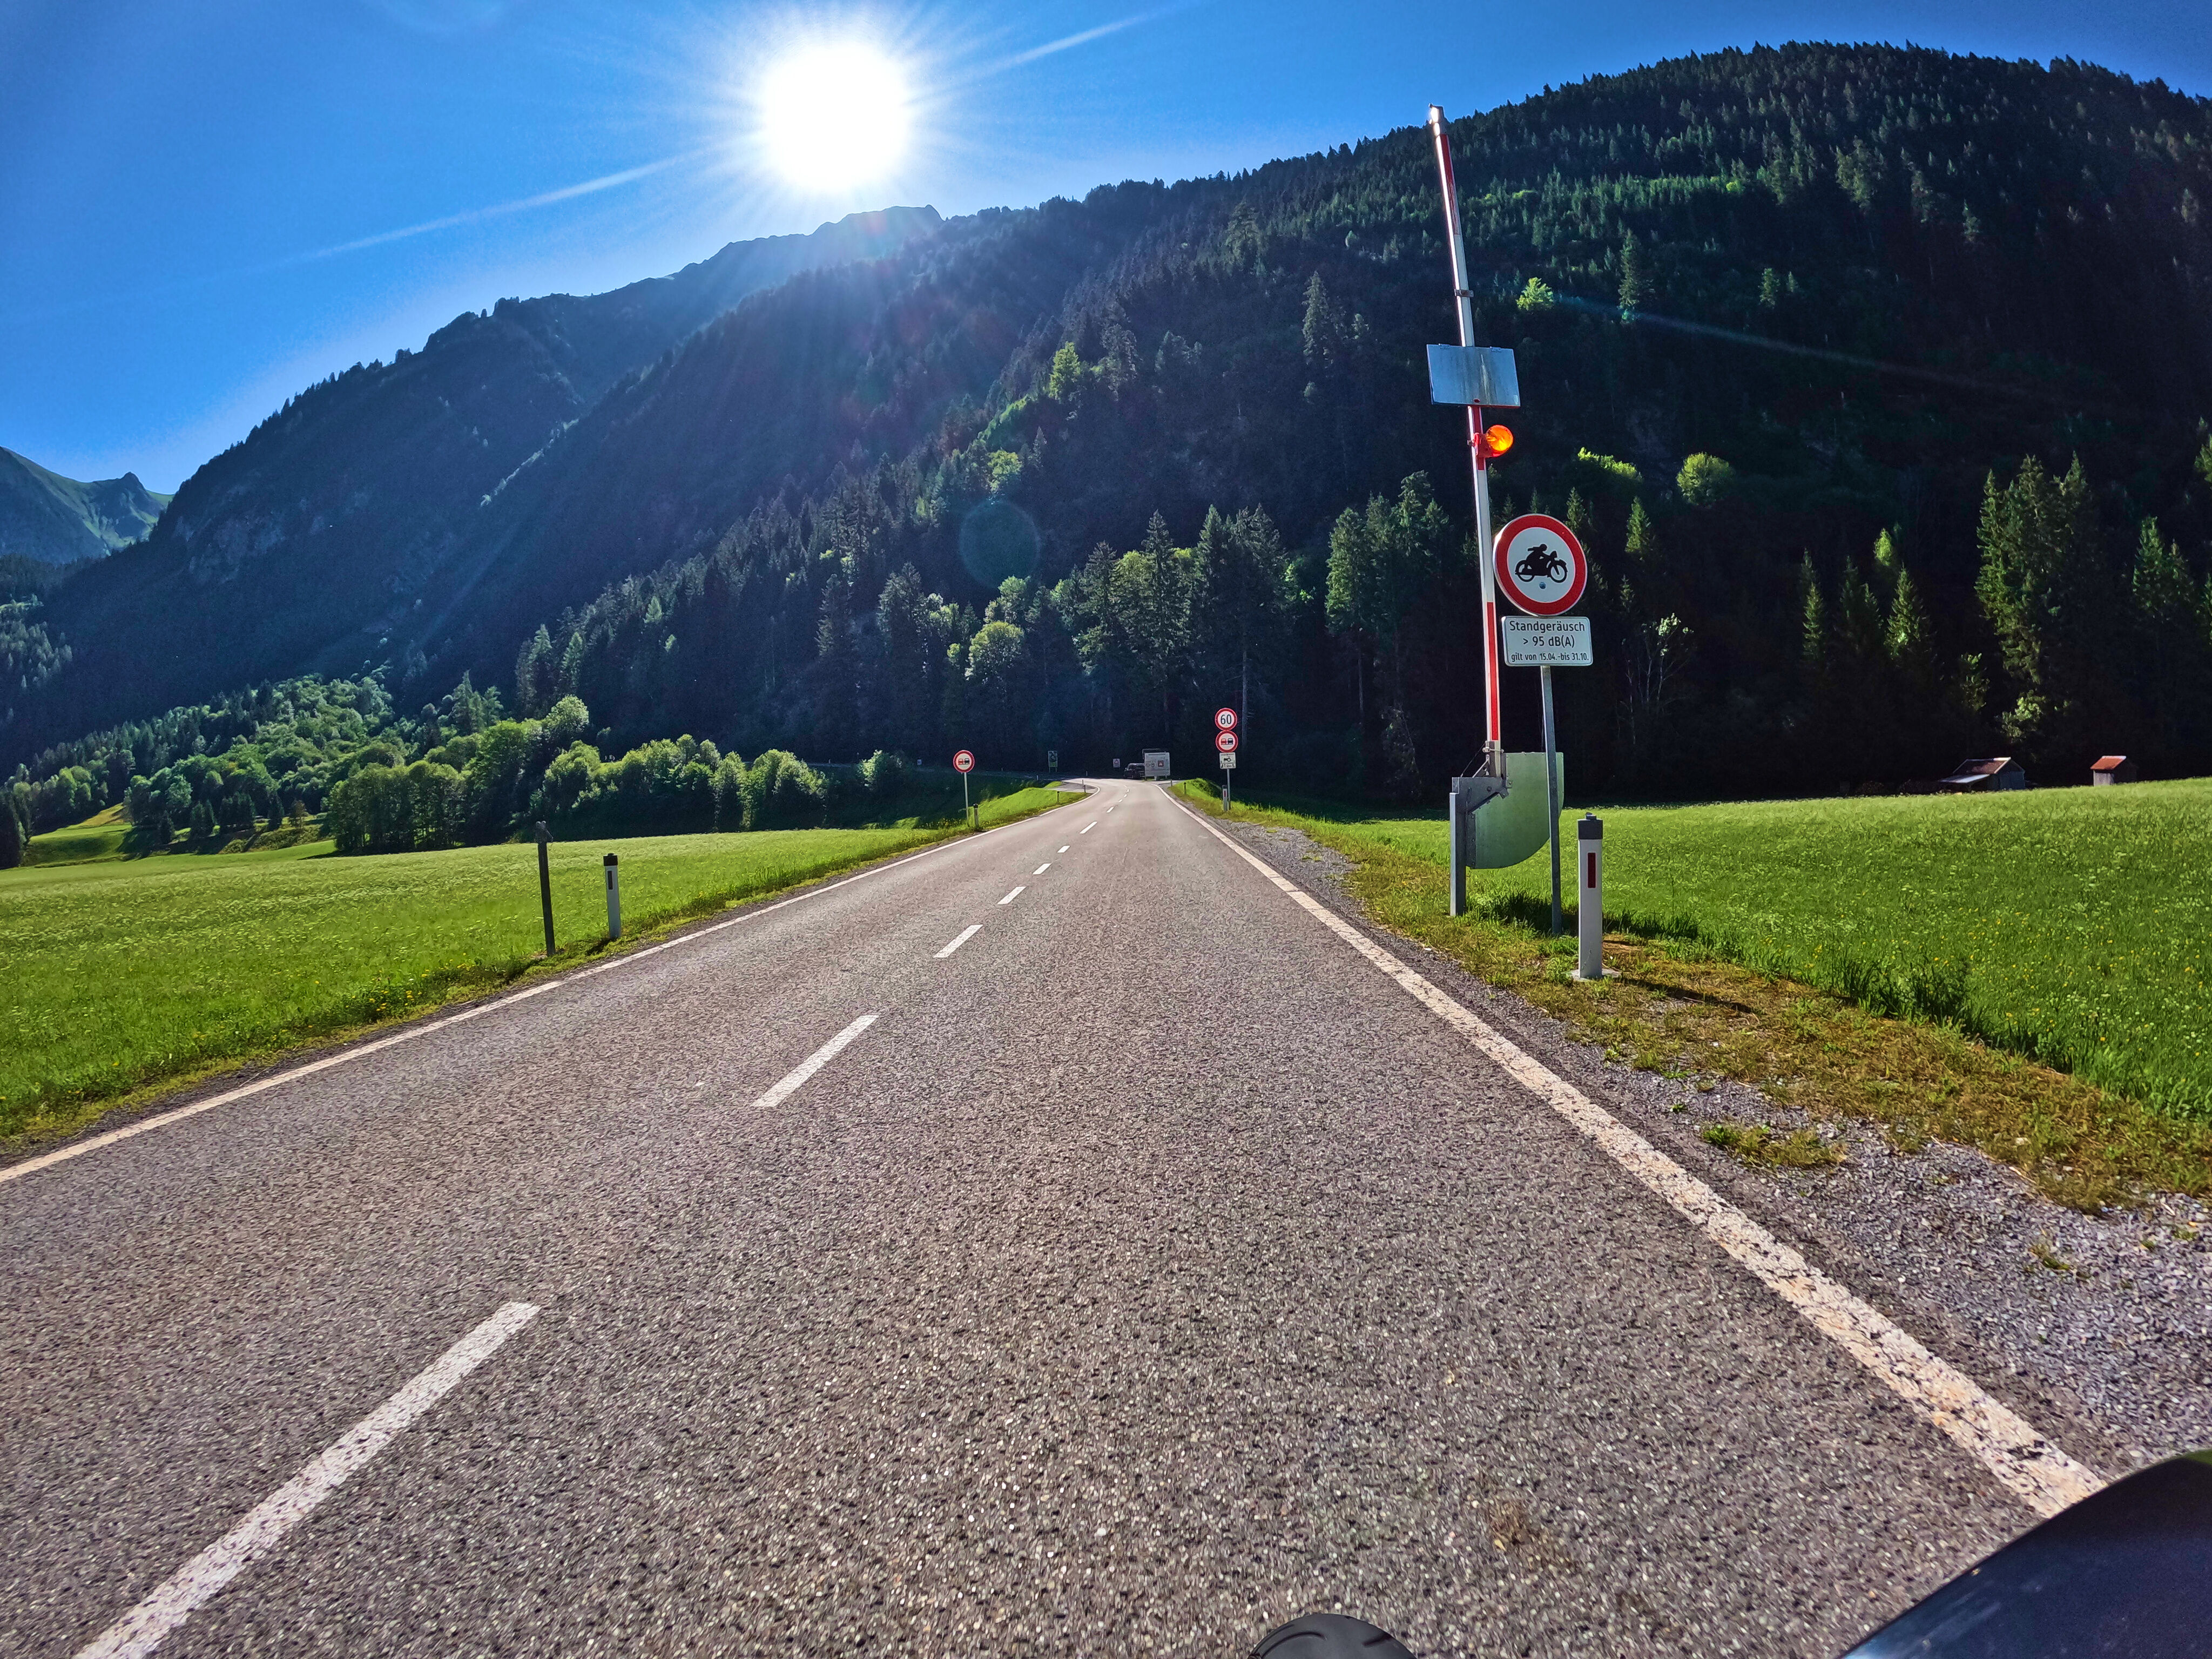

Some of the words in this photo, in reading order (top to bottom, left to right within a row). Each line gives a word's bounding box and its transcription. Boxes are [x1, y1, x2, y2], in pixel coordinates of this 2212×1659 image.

[1509, 621, 1585, 633] Standgeräusch
[1533, 636, 1545, 646] 95
[1548, 635, 1575, 648] dB(A)
[1511, 652, 1522, 662] gilt
[1572, 652, 1589, 660] 31.10.
[1220, 714, 1232, 725] 60
